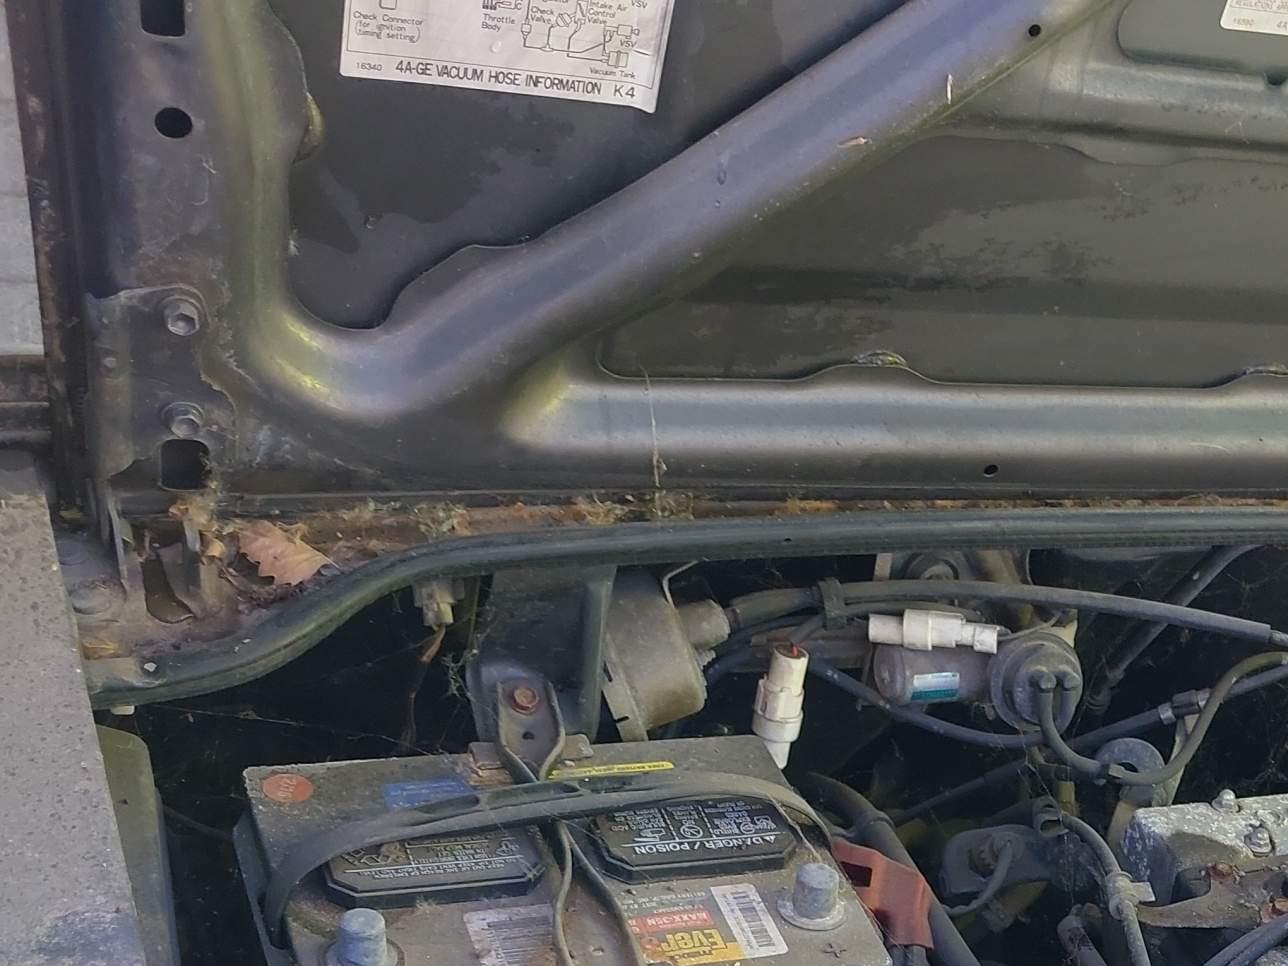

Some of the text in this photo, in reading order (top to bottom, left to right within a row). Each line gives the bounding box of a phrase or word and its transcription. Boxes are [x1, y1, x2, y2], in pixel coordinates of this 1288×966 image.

[530, 5, 554, 15] Check
[588, 7, 616, 18] Control
[353, 10, 424, 26] Check Connector
[483, 13, 516, 25] Throttle
[530, 14, 552, 25] Valve
[481, 21, 501, 32] Body
[619, 40, 638, 48] VSV
[395, 60, 434, 77] 4A-GE
[436, 63, 484, 83] VACUUM
[488, 70, 522, 88] HOSE
[525, 74, 602, 96] INFORMATION
[702, 835, 764, 849] DANGER
[634, 843, 690, 855] POISON
